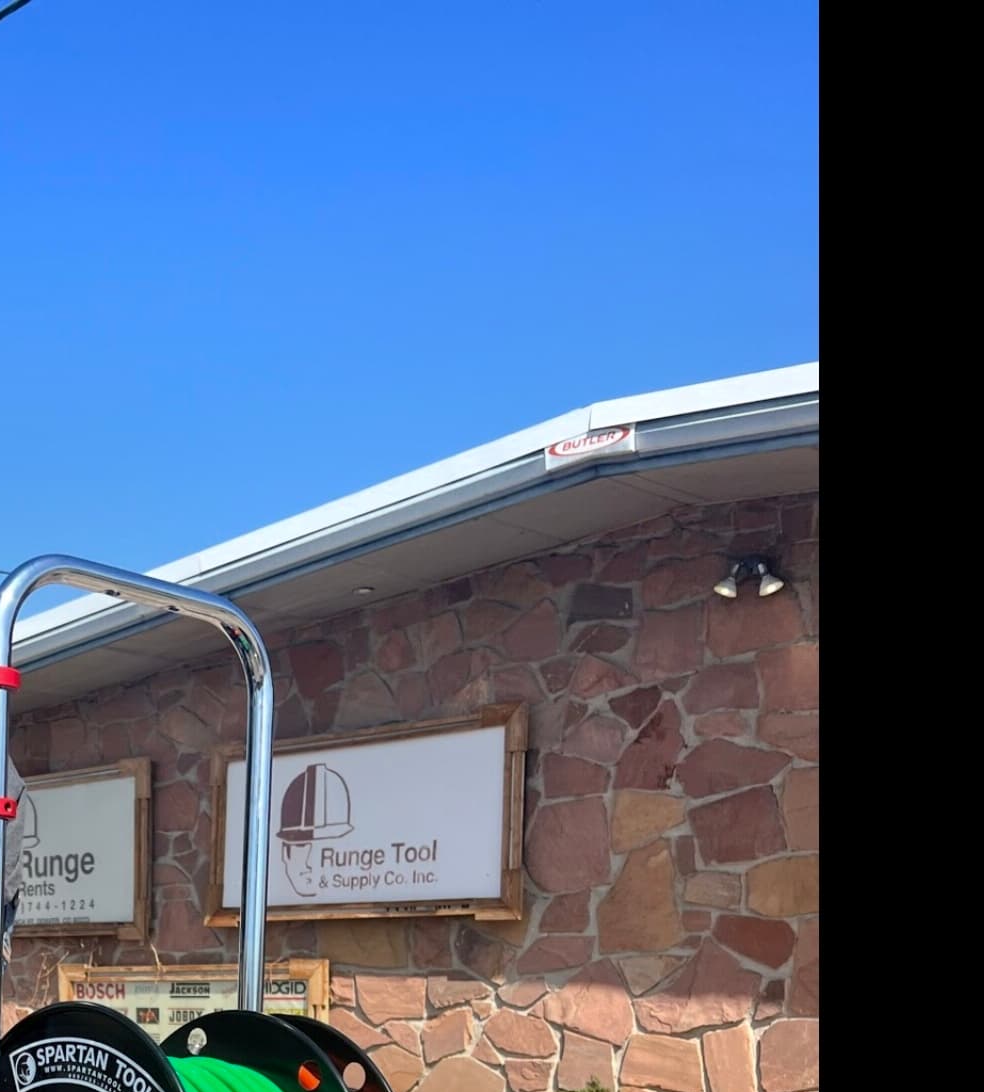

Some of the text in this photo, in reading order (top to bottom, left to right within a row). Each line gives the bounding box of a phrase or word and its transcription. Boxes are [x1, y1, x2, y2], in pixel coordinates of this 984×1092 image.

[562, 431, 616, 452] BUTLER
[320, 839, 437, 871] Runge Tool
[22, 850, 95, 883] Runge
[318, 869, 438, 891] & Supply Co. Inc.
[76, 983, 126, 1000] BOSCH
[265, 981, 307, 995] IDGID
[36, 1044, 109, 1071] SPARTAN
